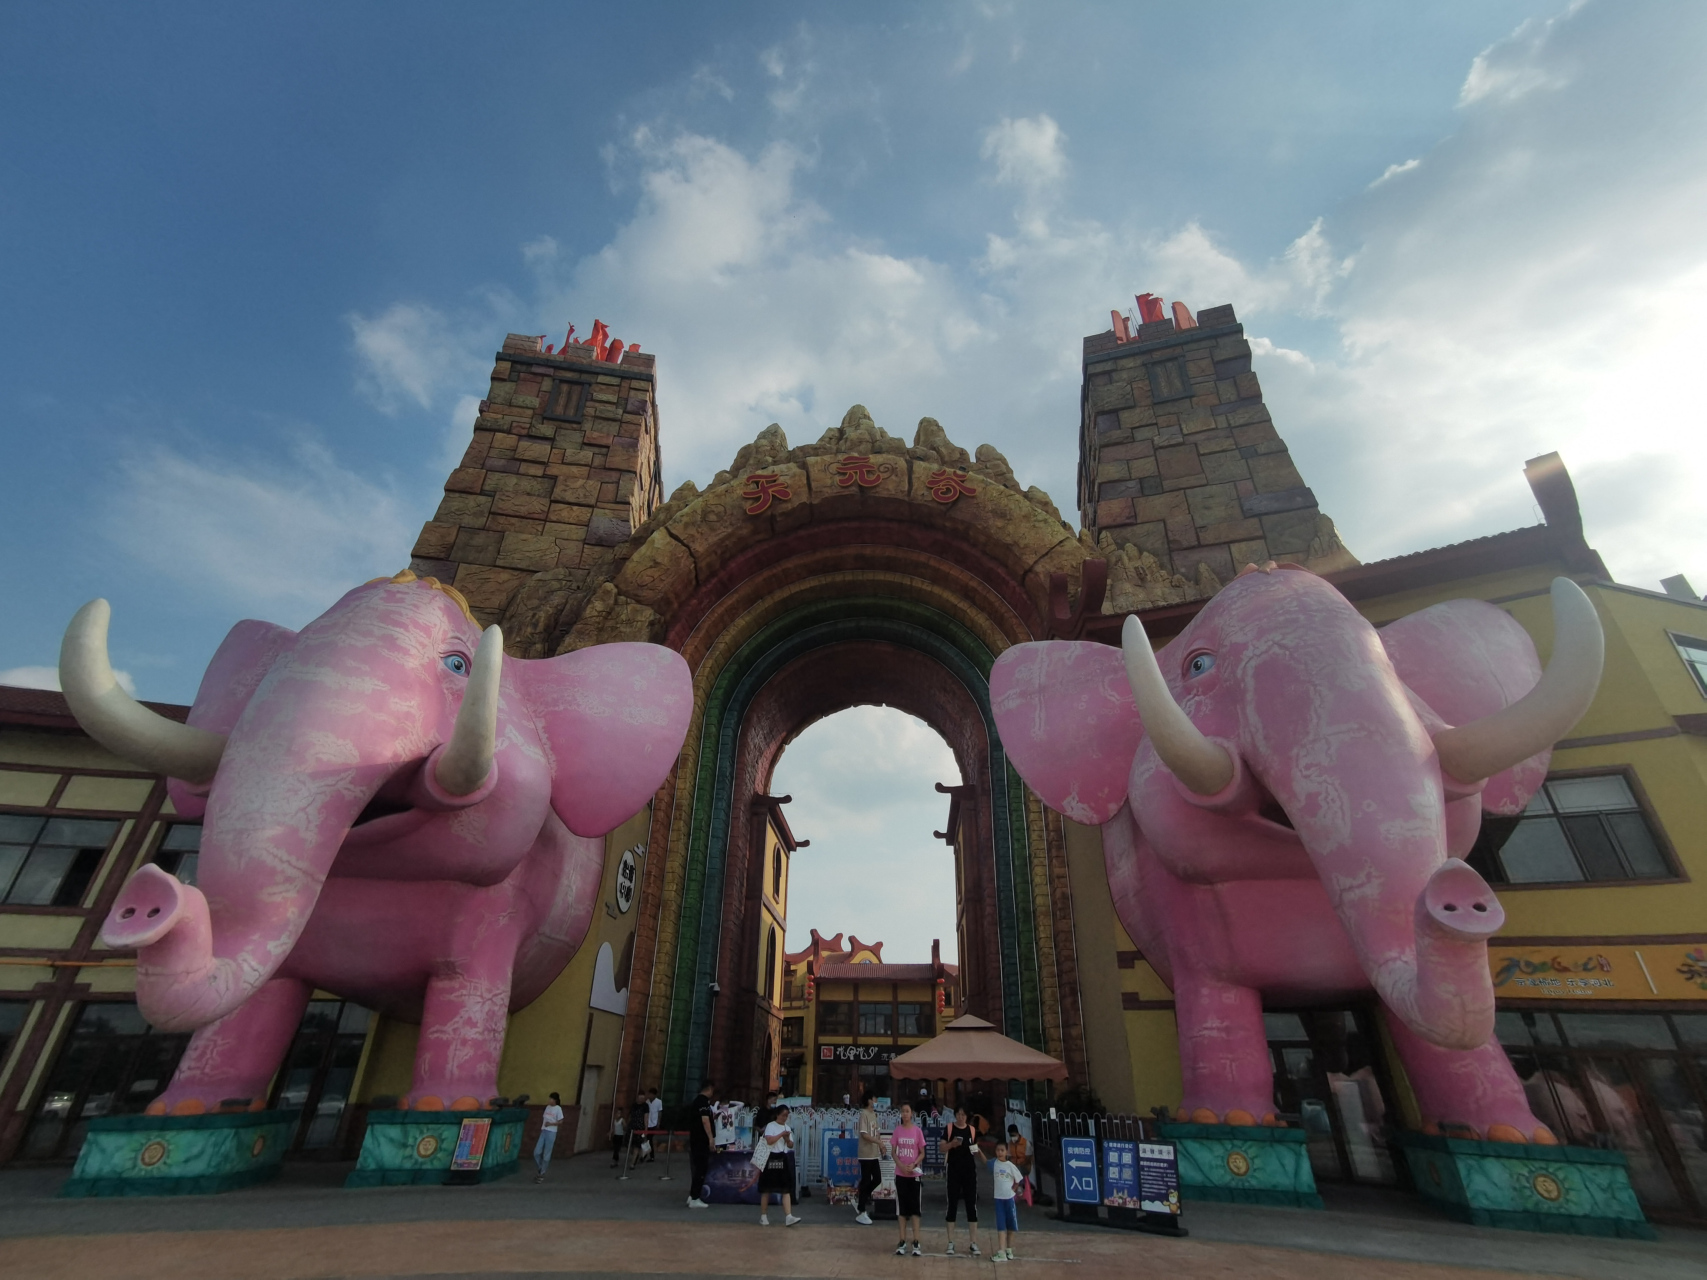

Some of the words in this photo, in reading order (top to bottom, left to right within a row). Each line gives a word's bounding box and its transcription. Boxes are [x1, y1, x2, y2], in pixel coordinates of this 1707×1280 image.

[742, 455, 977, 515] 天元谷
[1070, 1175, 1094, 1191] 入口
